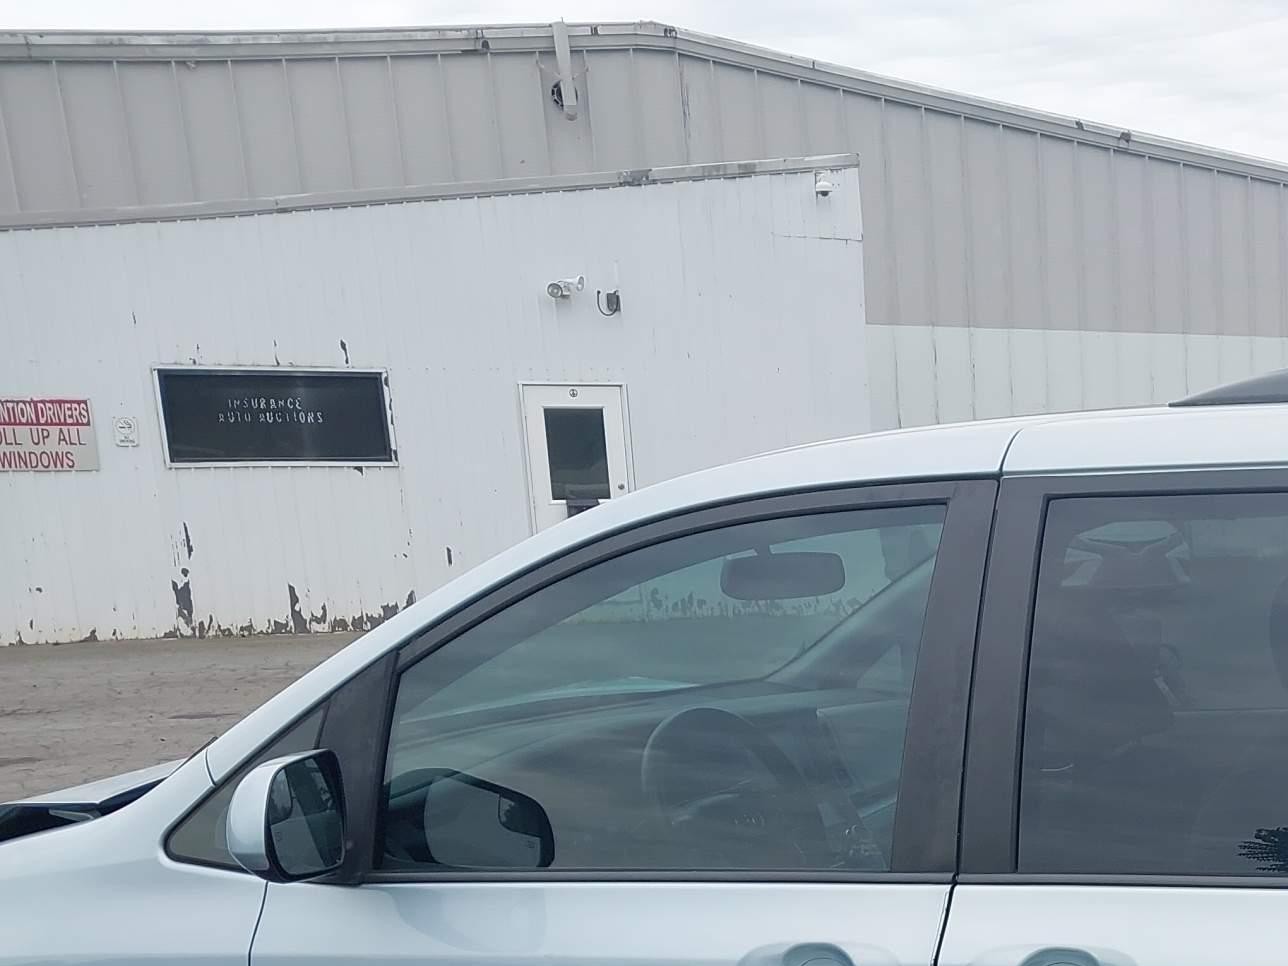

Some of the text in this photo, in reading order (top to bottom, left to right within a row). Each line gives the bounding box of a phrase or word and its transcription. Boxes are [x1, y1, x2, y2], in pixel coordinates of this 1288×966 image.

[227, 397, 302, 410] INSURANCE
[37, 402, 88, 424] DRIVERS
[0, 427, 87, 446] LL UP ALL
[0, 451, 75, 469] WINDOWS
